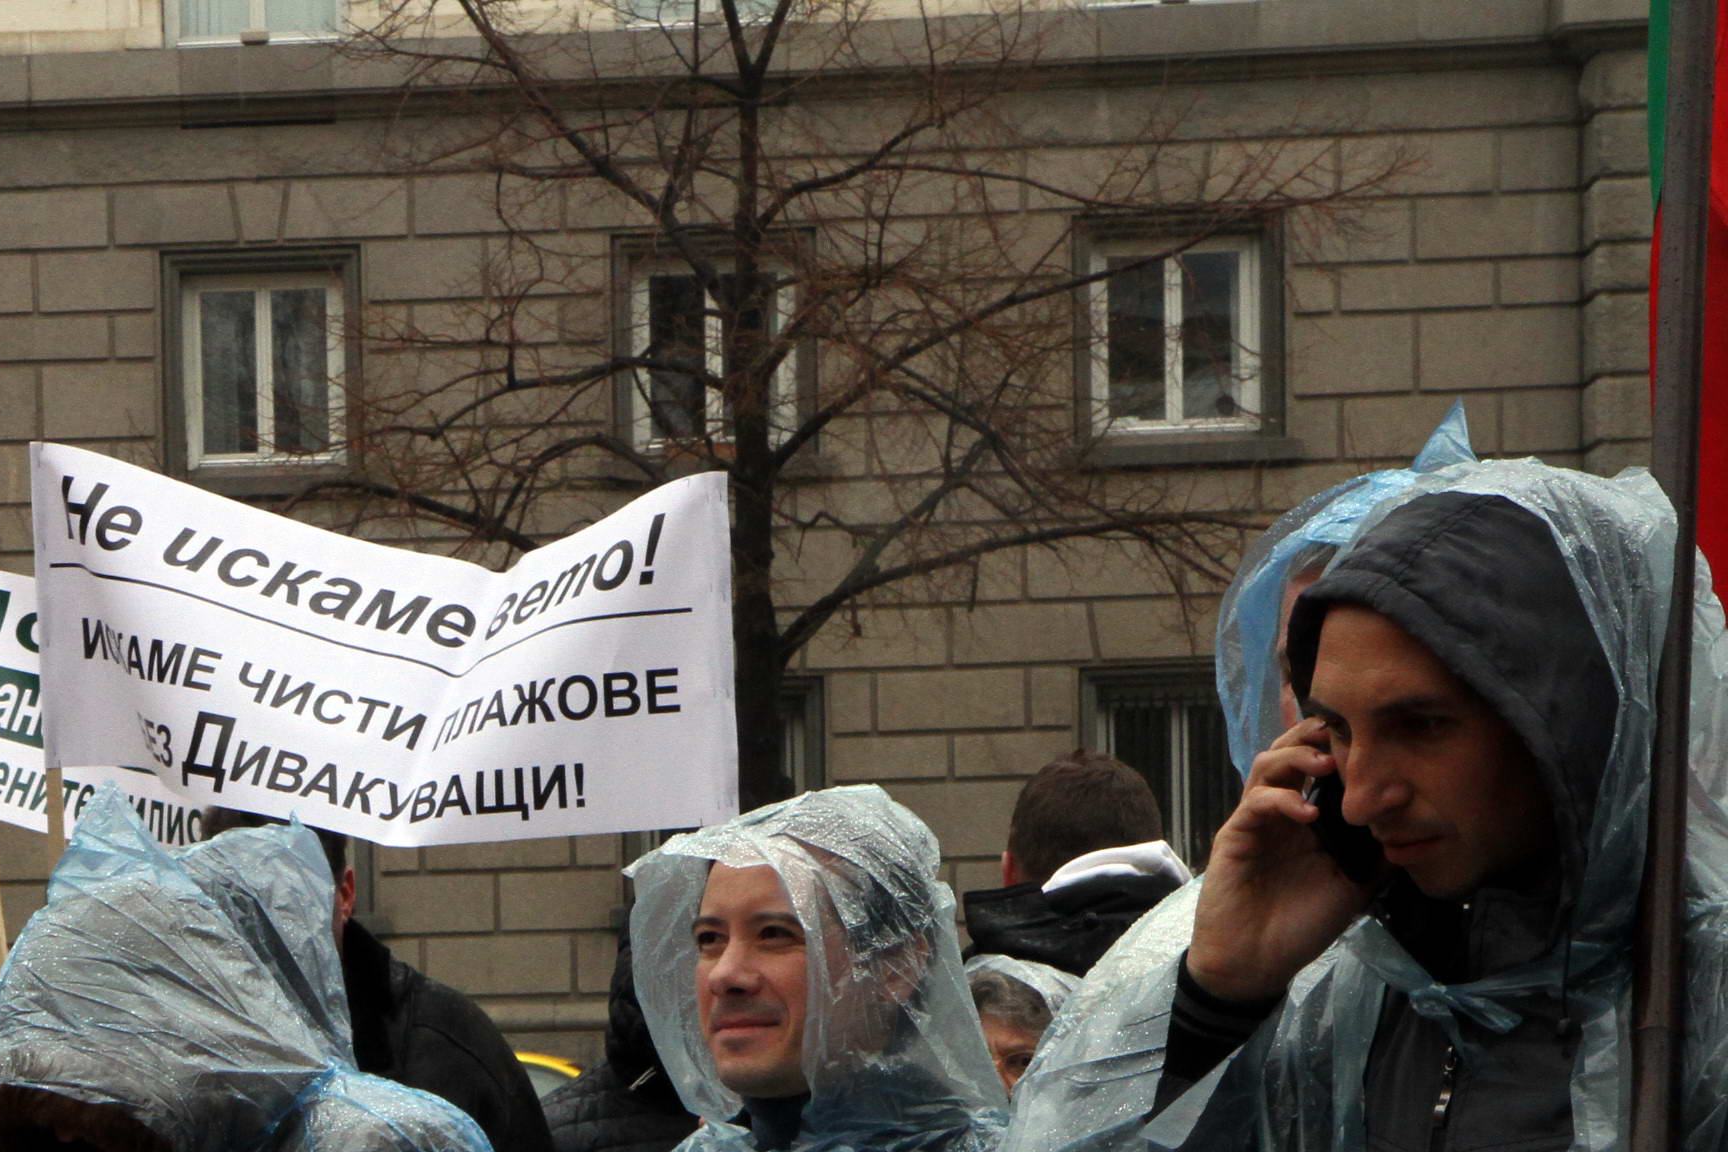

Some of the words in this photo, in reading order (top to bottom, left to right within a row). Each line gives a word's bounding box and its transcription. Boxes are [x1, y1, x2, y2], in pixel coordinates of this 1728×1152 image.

[62, 475, 143, 551] Не
[163, 527, 477, 648] искаме
[485, 513, 666, 641] вето!
[137, 711, 172, 768] ЕЗ
[238, 662, 427, 751] ЧИСТИ
[432, 668, 681, 751] ПЛАЖОВЕ
